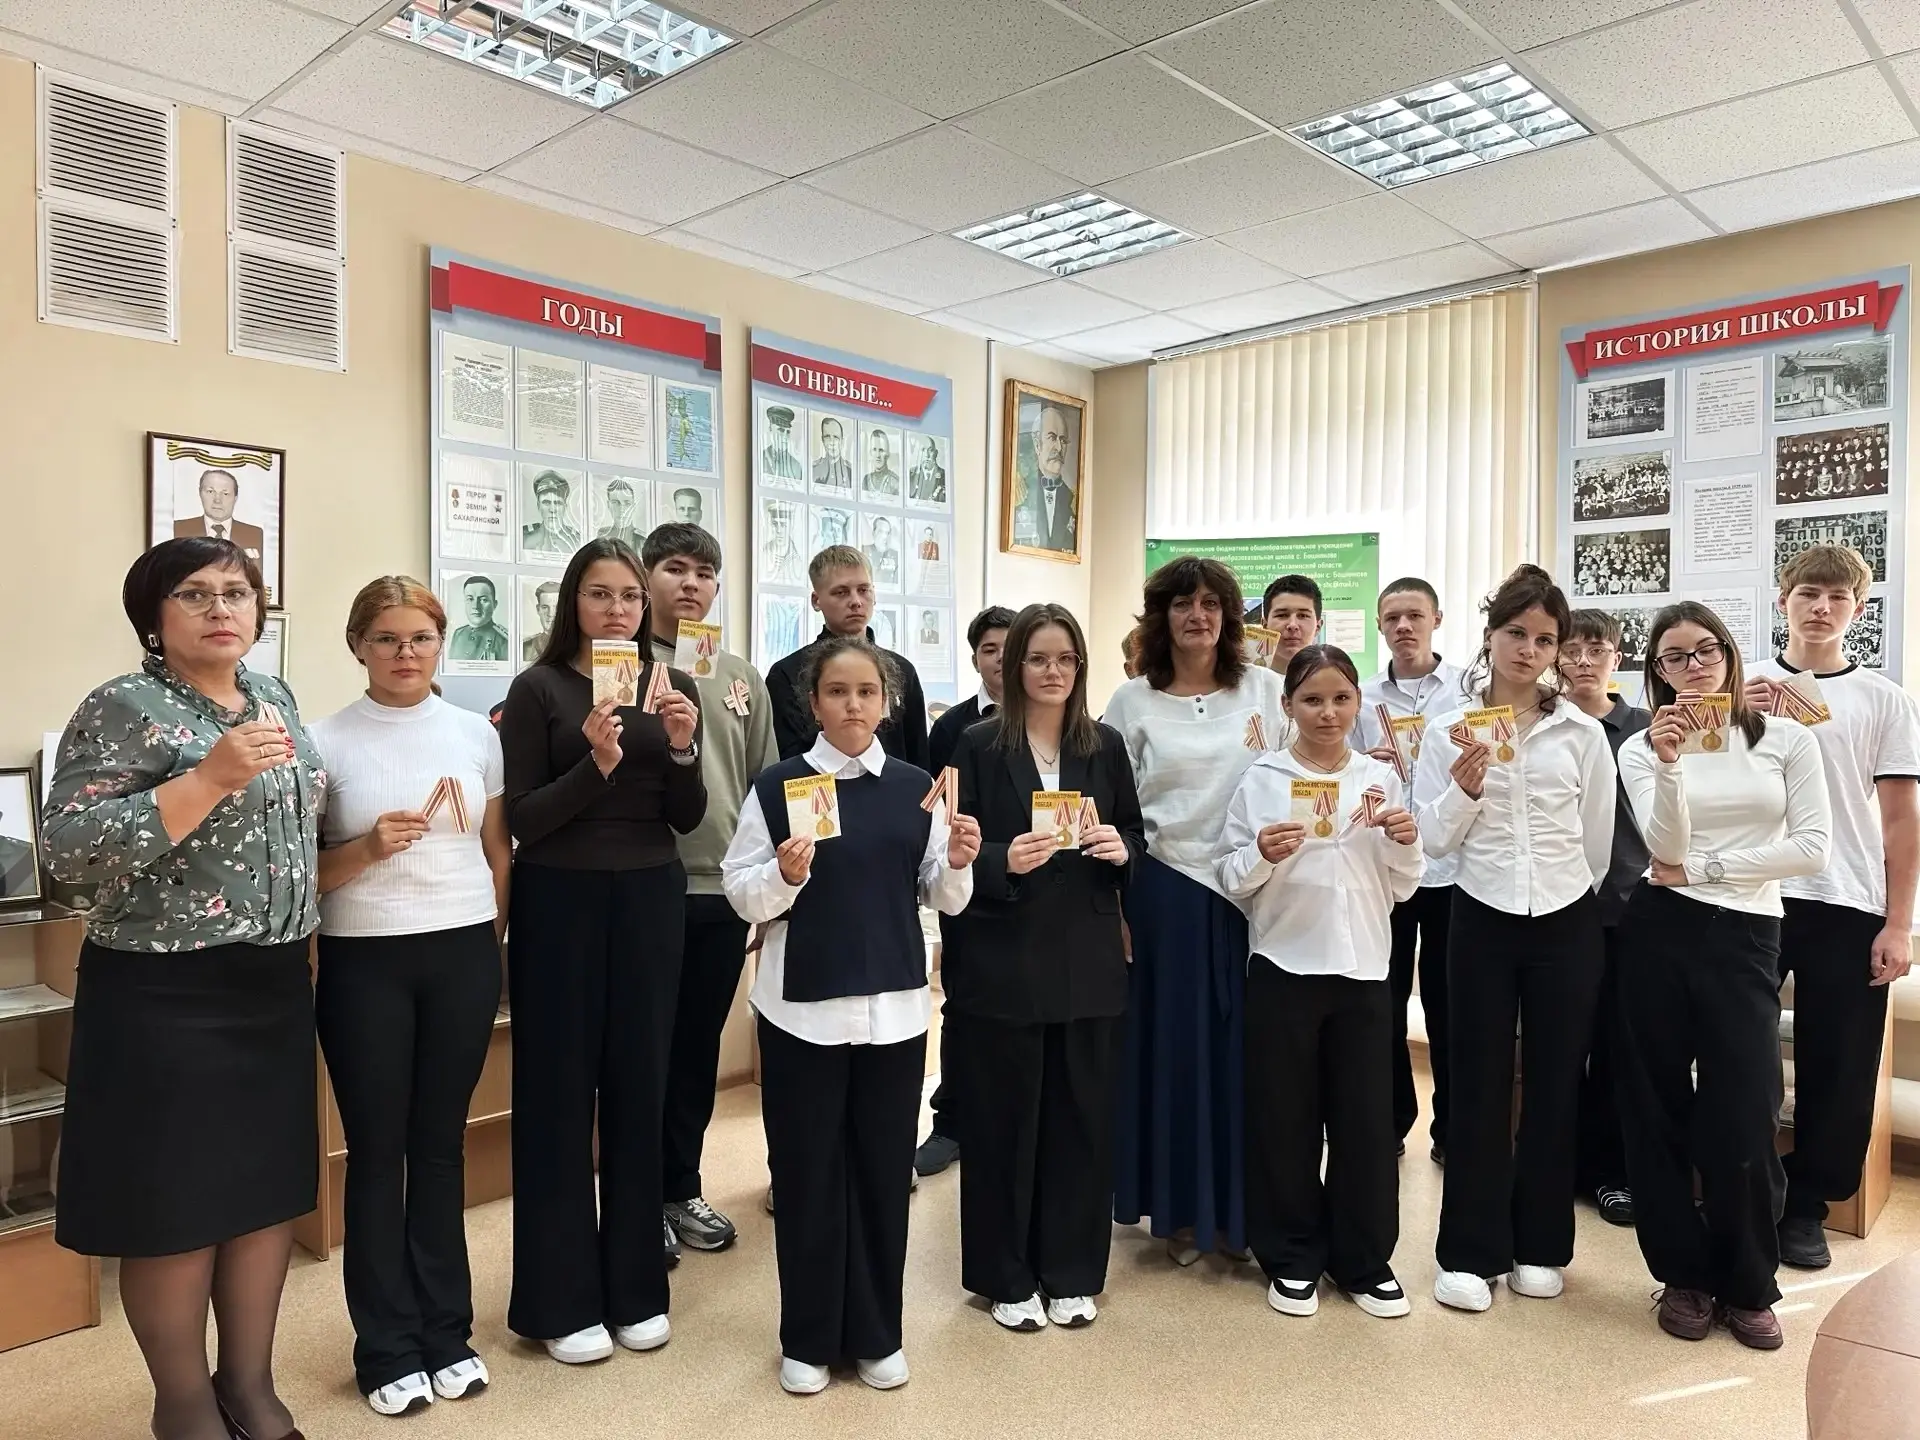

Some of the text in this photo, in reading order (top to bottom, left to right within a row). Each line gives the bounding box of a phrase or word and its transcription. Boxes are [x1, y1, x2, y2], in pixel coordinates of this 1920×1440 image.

[540, 296, 625, 339] ГОДЫ
[1594, 294, 1868, 361] ИСТОРИЯ ШКОЛЫ
[778, 363, 893, 408] ОГНЕВЫЕ...
